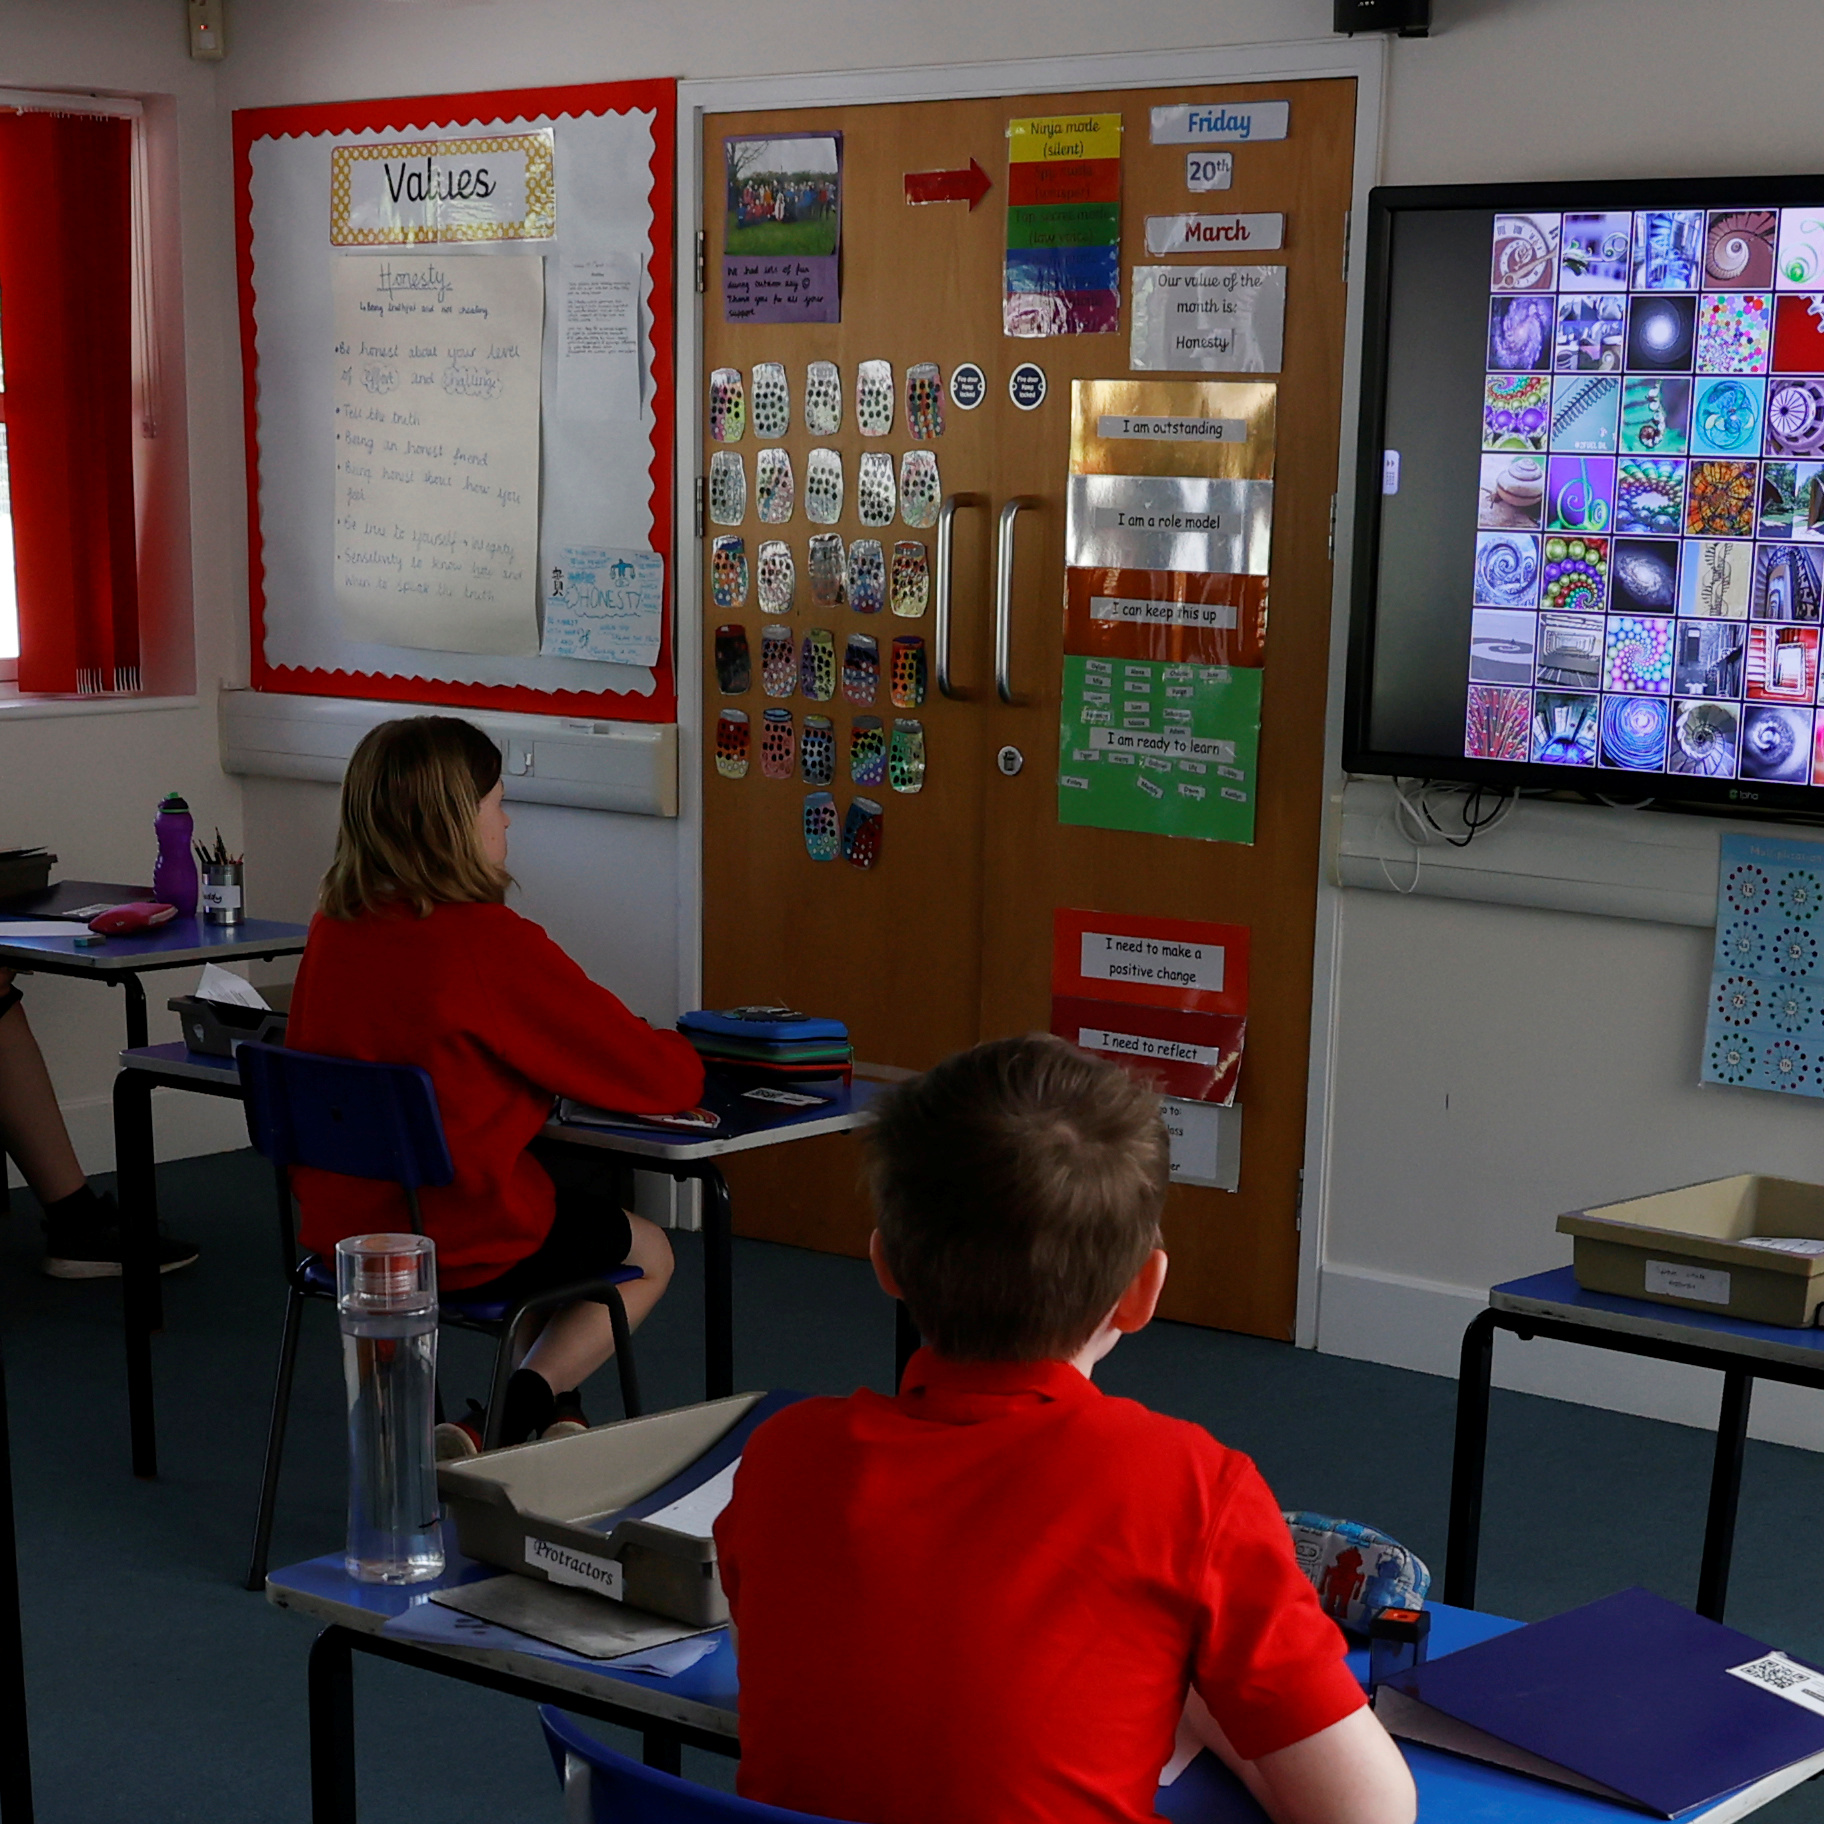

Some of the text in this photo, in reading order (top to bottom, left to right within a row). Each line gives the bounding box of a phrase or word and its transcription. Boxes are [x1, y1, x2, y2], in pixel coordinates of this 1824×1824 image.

[1031, 118, 1100, 138] Ninja mode
[1188, 110, 1251, 138] Friday
[1043, 141, 1084, 158] (silent)
[384, 157, 496, 203] Values
[1190, 159, 1230, 181] 20th
[1185, 220, 1250, 242] March
[1158, 273, 1263, 292] Our value of the
[1177, 300, 1220, 314] month
[1176, 335, 1230, 352] Honesty
[1123, 419, 1223, 439] I am outstanding
[1118, 513, 1220, 529] I am a role model
[1112, 602, 1119, 615] I
[1123, 604, 1142, 616] can
[1146, 603, 1173, 620] keep
[1203, 610, 1216, 624] up
[1107, 731, 1219, 755] I am ready to learn
[1106, 937, 1202, 960] I need to make a
[1109, 963, 1196, 986] positive change
[1103, 1033, 1197, 1060] I need to reflect
[534, 1539, 613, 1585] Protractors
